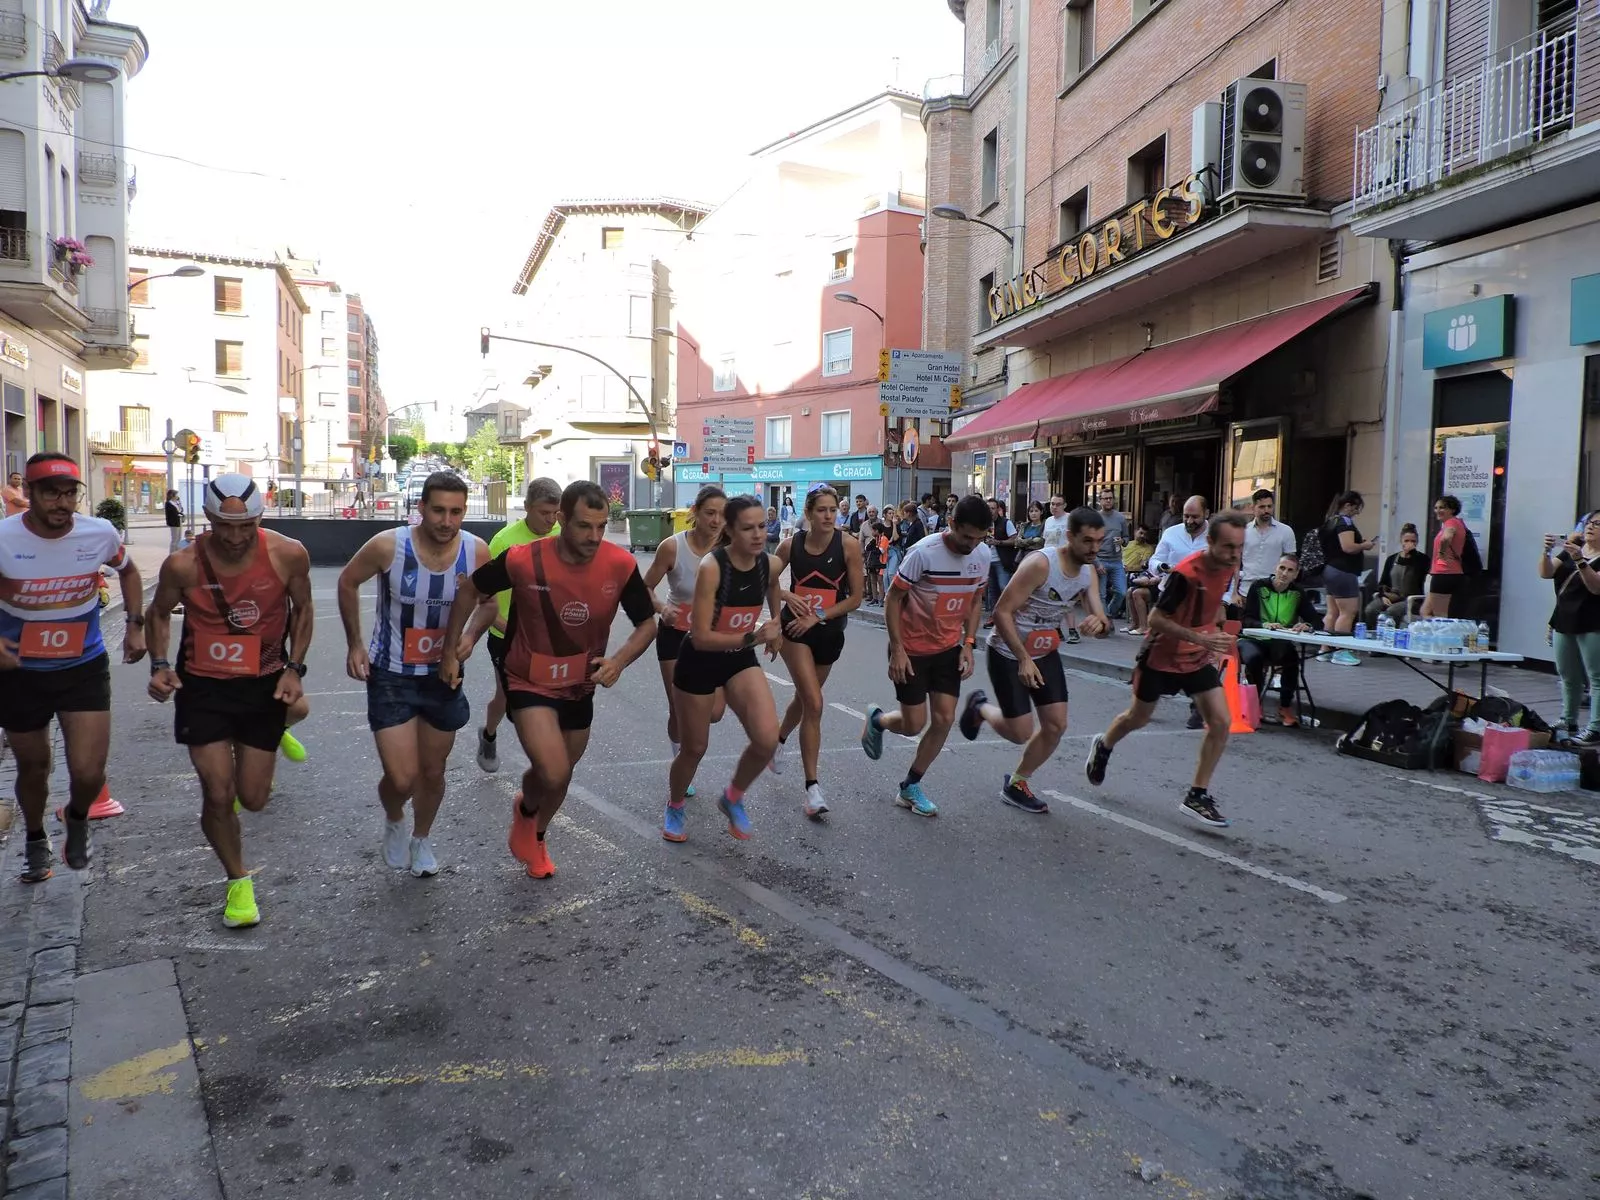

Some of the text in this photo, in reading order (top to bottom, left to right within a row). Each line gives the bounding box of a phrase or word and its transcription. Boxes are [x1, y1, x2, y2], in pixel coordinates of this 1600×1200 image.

[988, 174, 1206, 321] CINE CORTES
[927, 363, 961, 372] Gran Hotel
[916, 374, 933, 382] Hotel
[942, 375, 959, 383] Casa
[881, 383, 929, 393] Hotel Clemente
[880, 394, 924, 403] Hostal Palafox
[1449, 456, 1472, 464] Trae tu
[688, 471, 710, 481] GRACIA
[758, 470, 784, 480] GRACIA
[843, 467, 873, 478] GRACIA
[1471, 472, 1489, 480] hasta
[946, 598, 965, 611] 01
[729, 612, 755, 629] 09
[40, 630, 69, 648] 10
[417, 635, 445, 653] 04
[1033, 636, 1053, 649] 03
[209, 641, 244, 663] 02
[550, 663, 569, 680] 11
